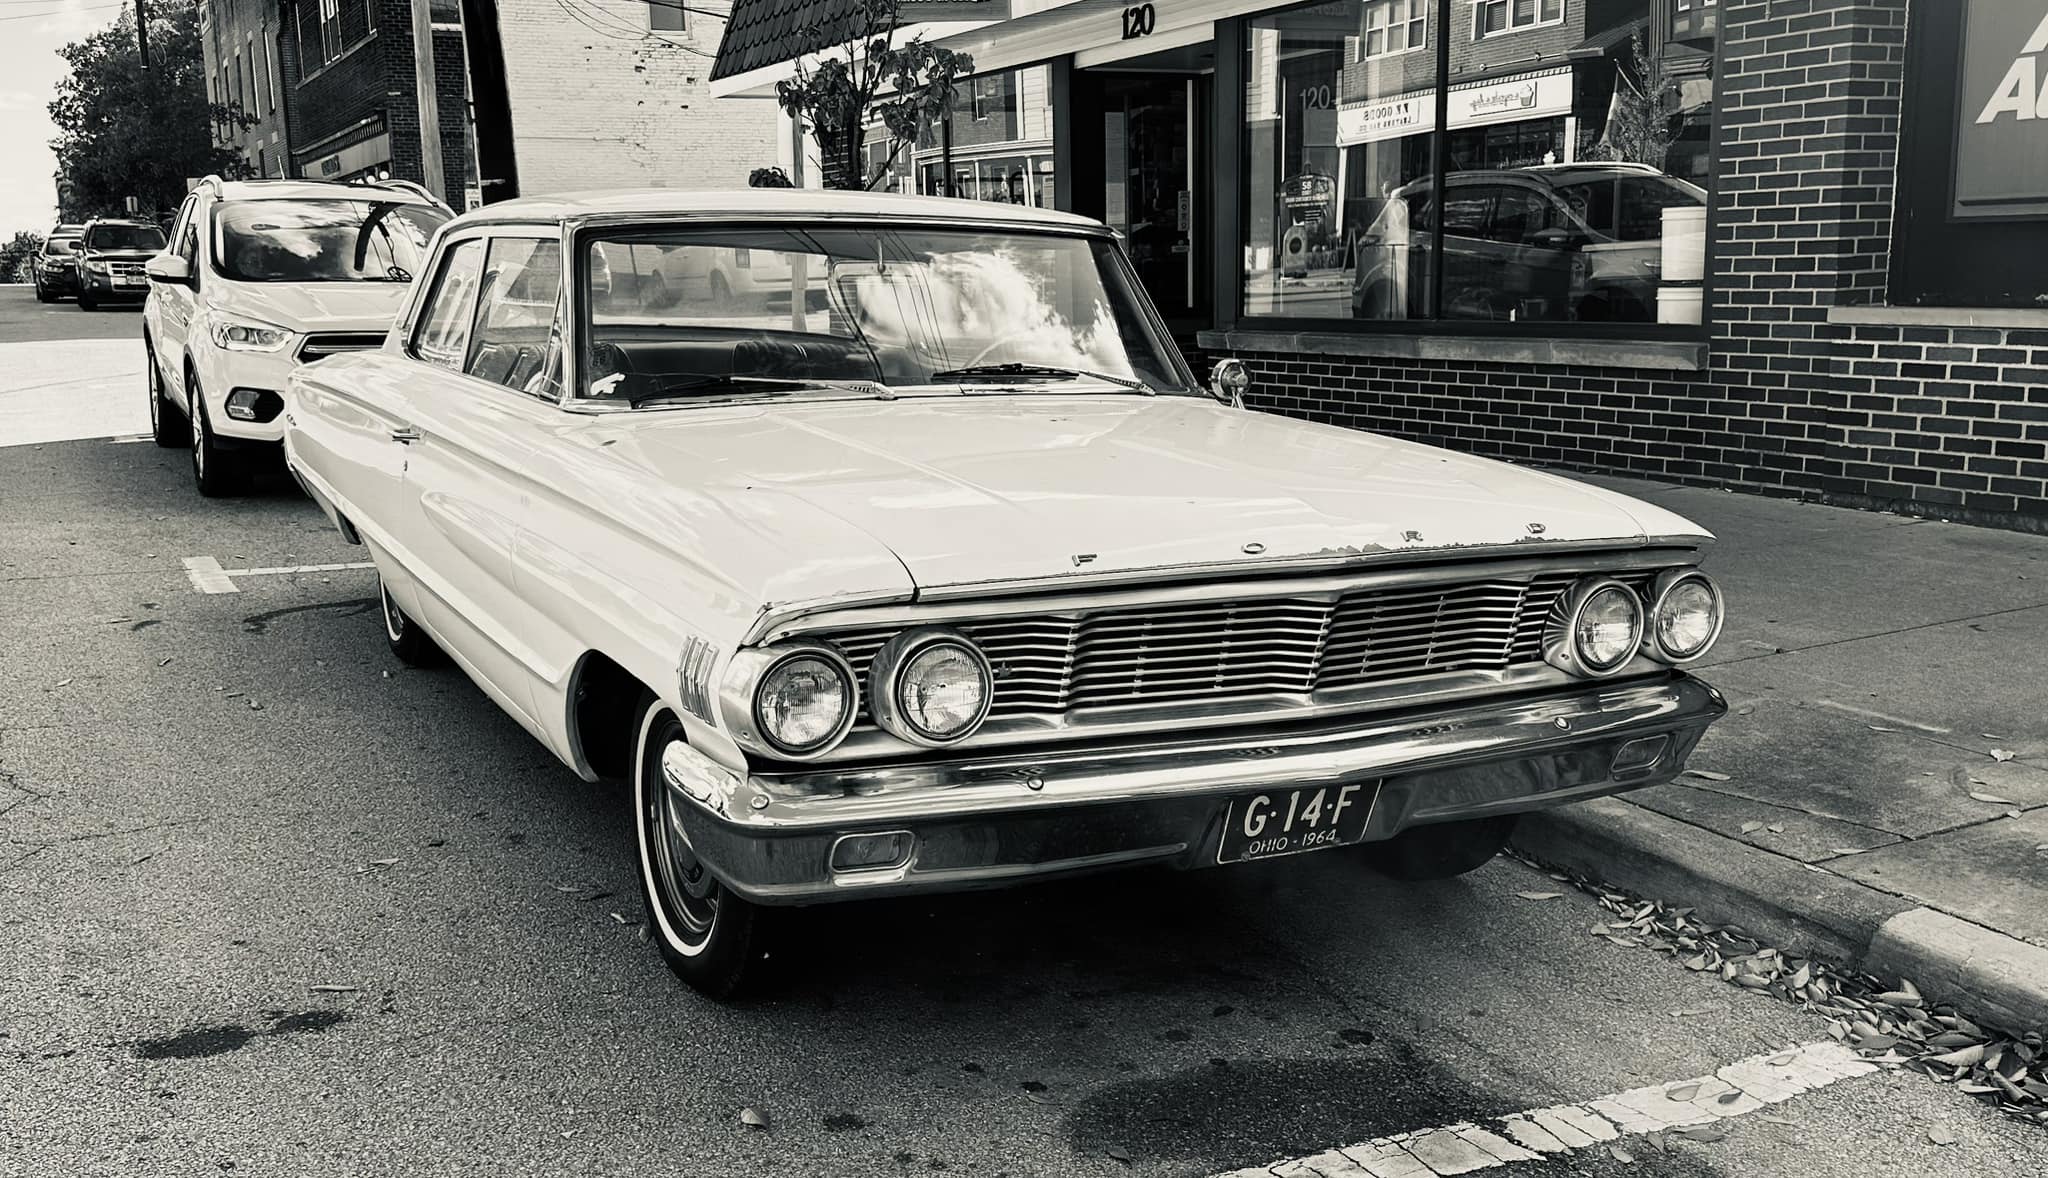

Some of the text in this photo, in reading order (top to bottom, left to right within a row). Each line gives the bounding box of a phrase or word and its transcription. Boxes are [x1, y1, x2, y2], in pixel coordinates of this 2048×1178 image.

[1121, 3, 1155, 40] 120
[1975, 56, 2048, 124] A
[1250, 837, 1288, 854] OHIO
[1302, 829, 1337, 846] 1964
